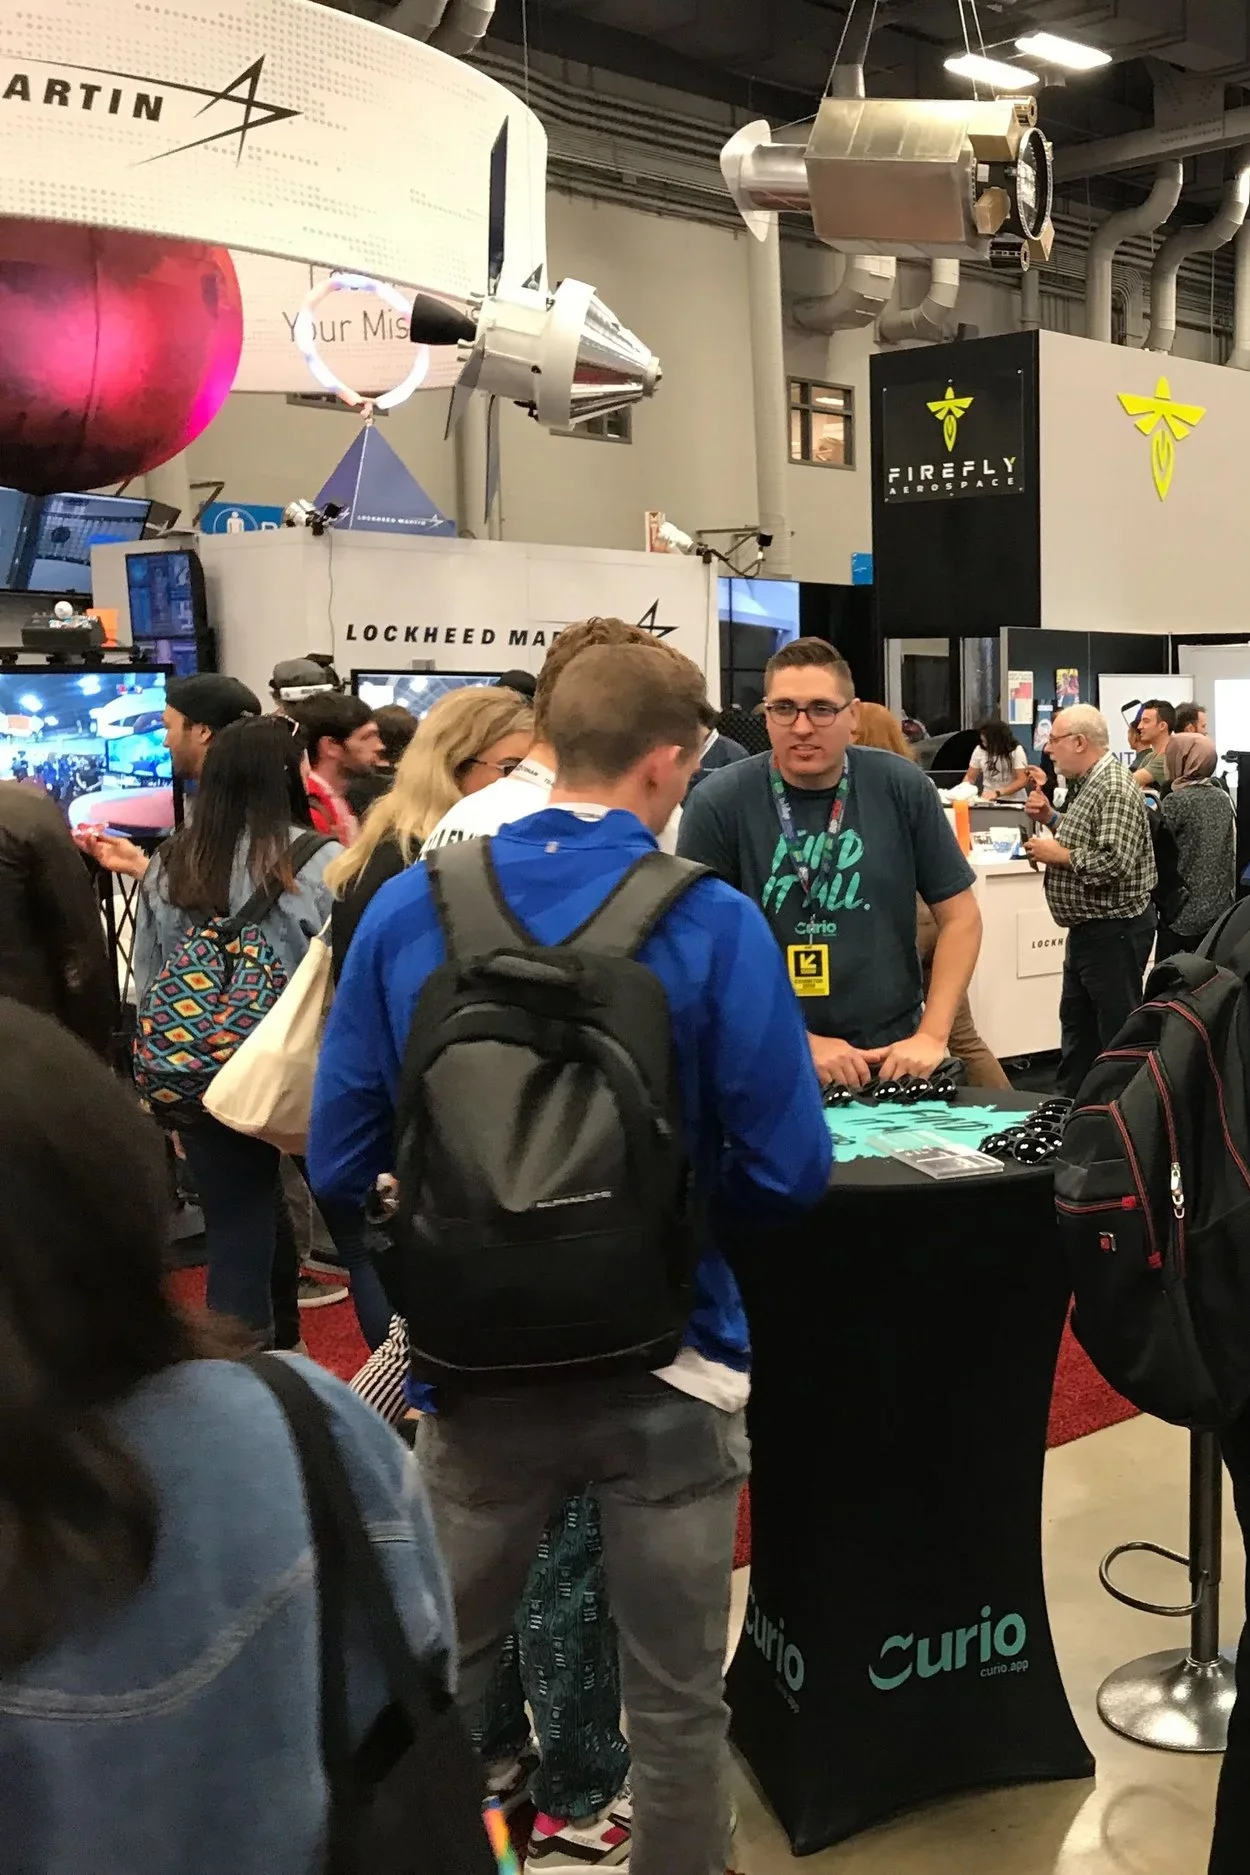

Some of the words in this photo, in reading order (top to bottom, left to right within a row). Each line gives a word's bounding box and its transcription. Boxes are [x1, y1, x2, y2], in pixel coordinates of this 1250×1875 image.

[2, 73, 164, 122] ARTIN
[282, 310, 352, 342] Yur
[888, 456, 1017, 484] FIREFLY
[889, 477, 1015, 495] AEROSPACE
[346, 623, 496, 646] LOCKHEED
[1031, 938, 1064, 949] LOCKH
[868, 1604, 1027, 1691] Curio
[979, 1659, 1029, 1678] curio.app
